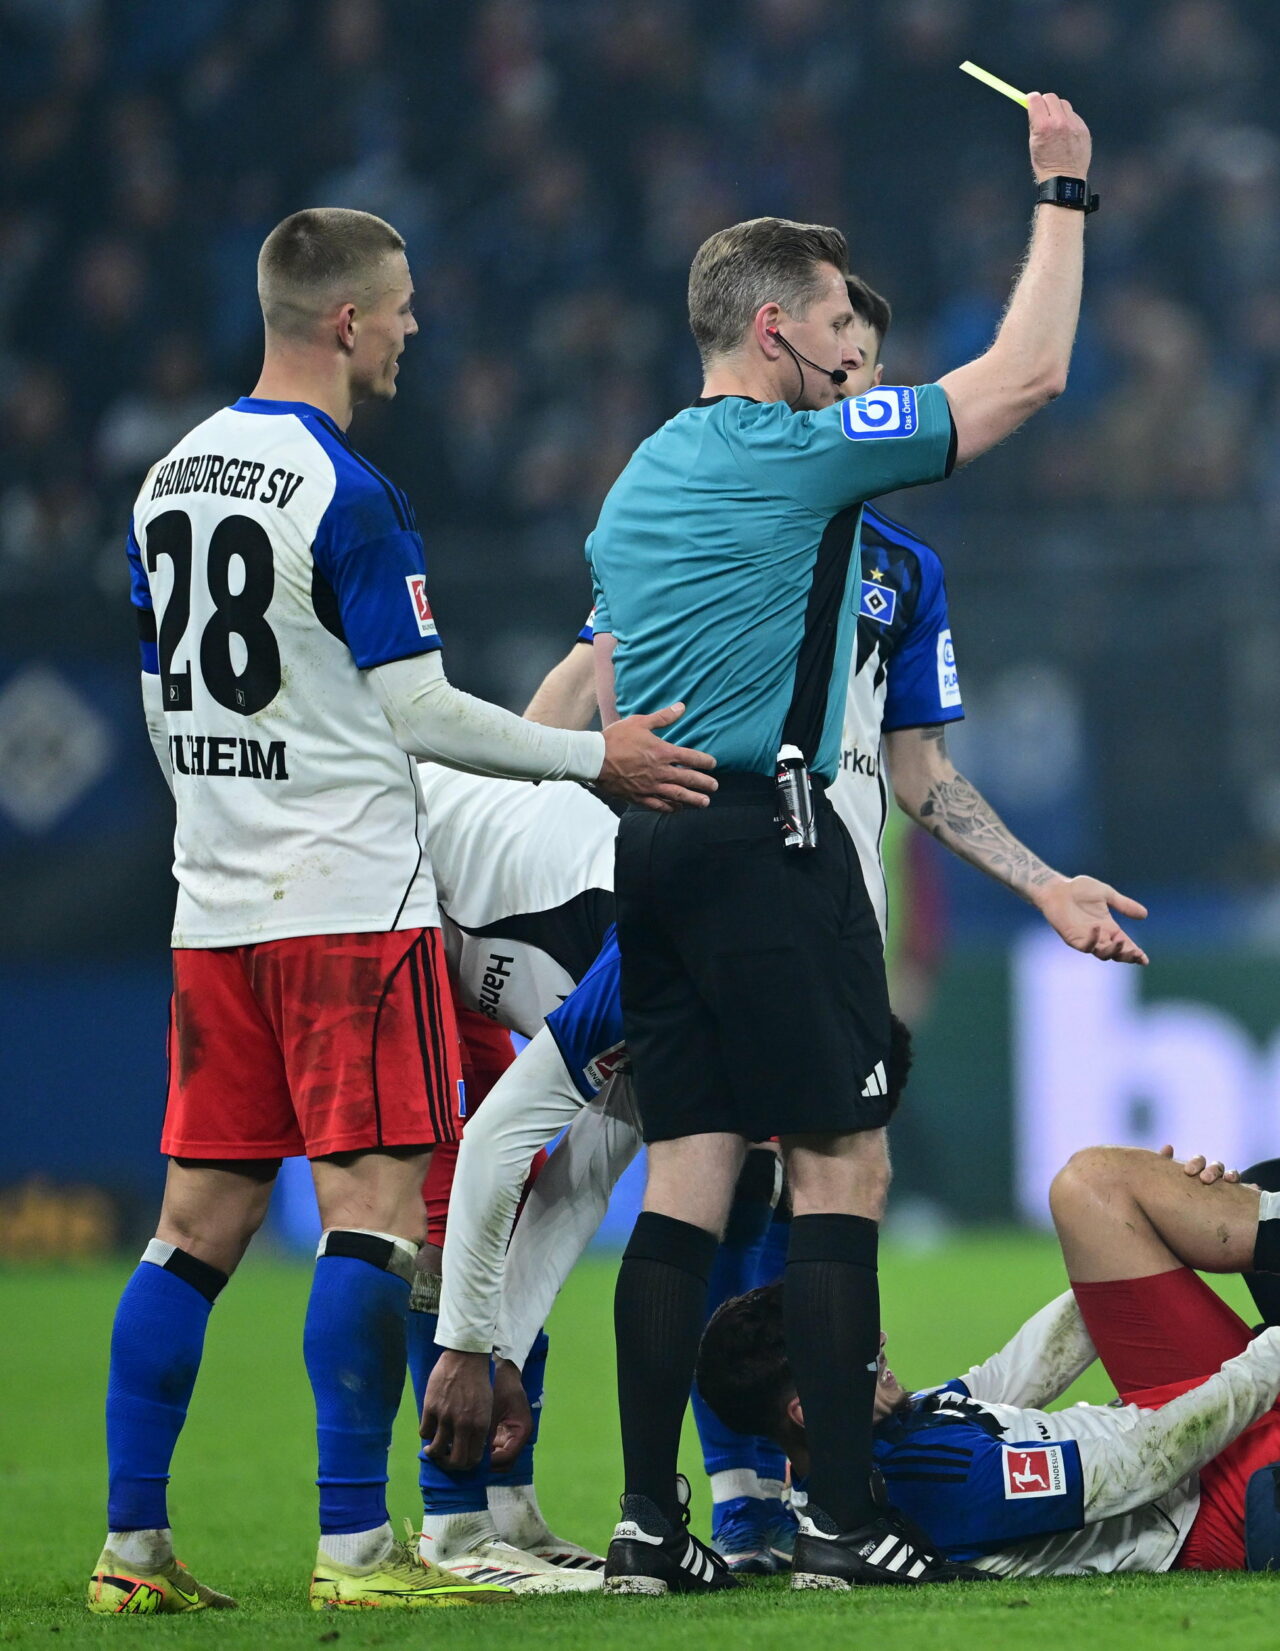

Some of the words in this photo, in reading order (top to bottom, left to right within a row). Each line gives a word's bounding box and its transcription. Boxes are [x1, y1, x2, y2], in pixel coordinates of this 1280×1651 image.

[151, 454, 265, 501] HAMBURGER
[259, 468, 304, 509] SV
[146, 510, 281, 716] 28
[169, 735, 289, 780] UHEIM
